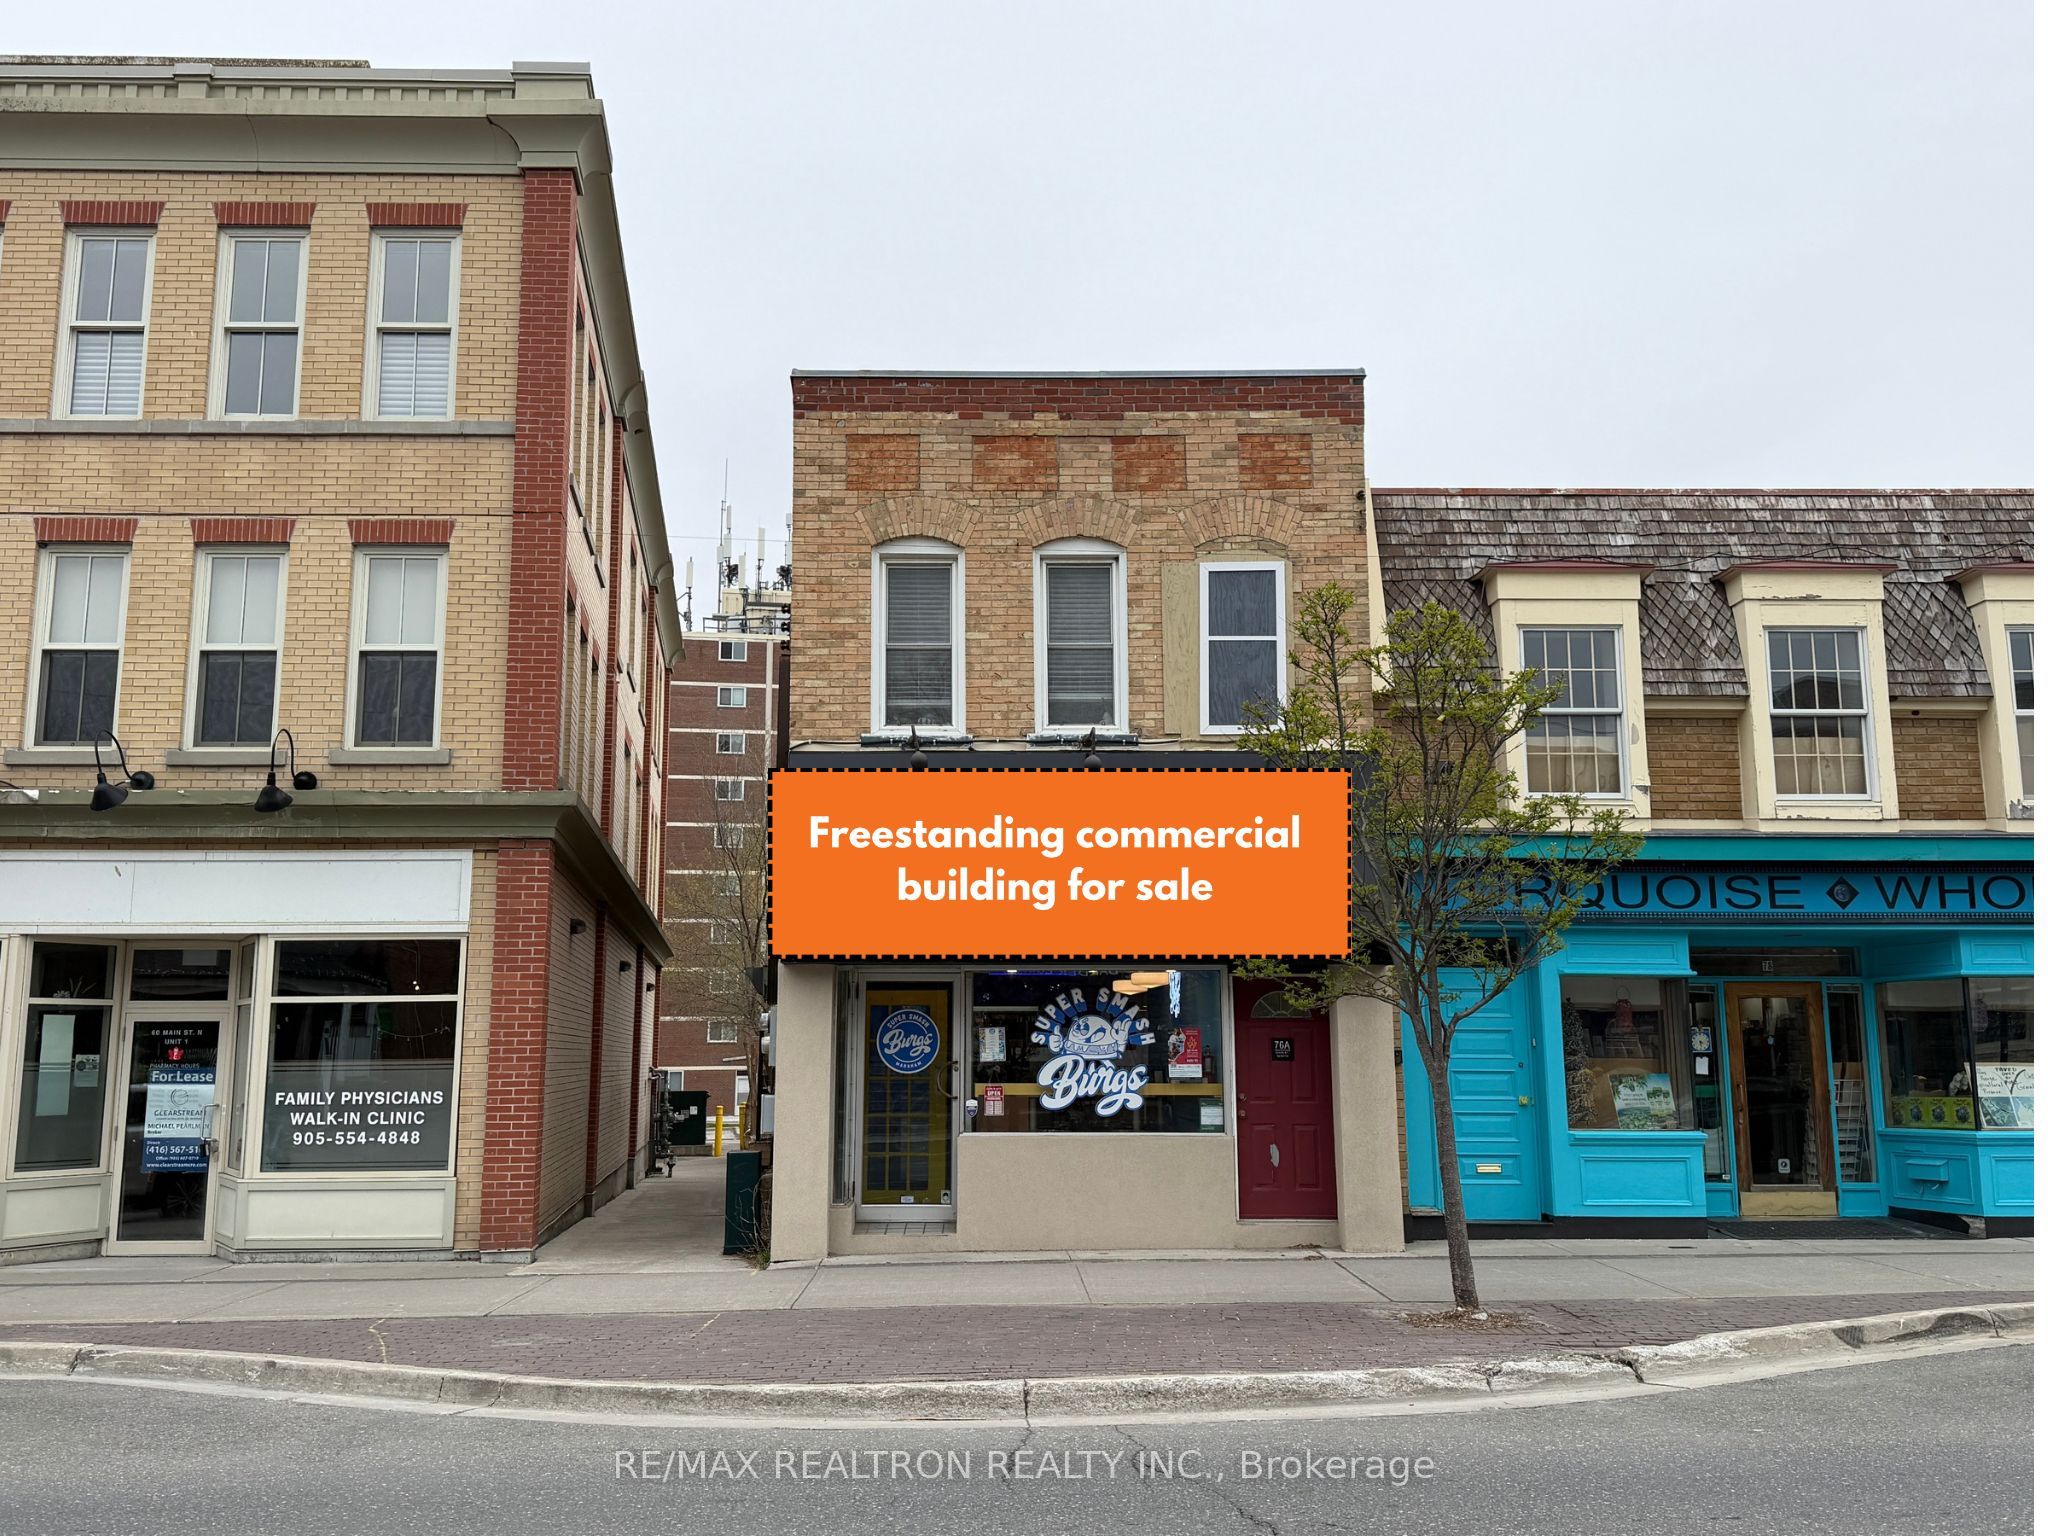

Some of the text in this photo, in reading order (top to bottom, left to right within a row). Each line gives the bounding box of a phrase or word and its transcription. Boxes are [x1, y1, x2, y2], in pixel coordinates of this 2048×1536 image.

[1428, 873, 2034, 911] RQUOISE WHO
[887, 1014, 930, 1028] SUPER SMASH
[1031, 987, 1087, 1045] SUPER
[1097, 987, 1156, 1045] SMASH
[883, 1029, 933, 1056] Burgs
[1273, 1040, 1291, 1050] 76A
[151, 1070, 214, 1082] For Lease
[1038, 1054, 1148, 1117] Burgs
[275, 1091, 444, 1105] FAMILY PHYSICIANS
[290, 1111, 425, 1125] WALK-IN CLINIC
[292, 1131, 421, 1145] 905-554-4848
[146, 1145, 168, 1155] (416)
